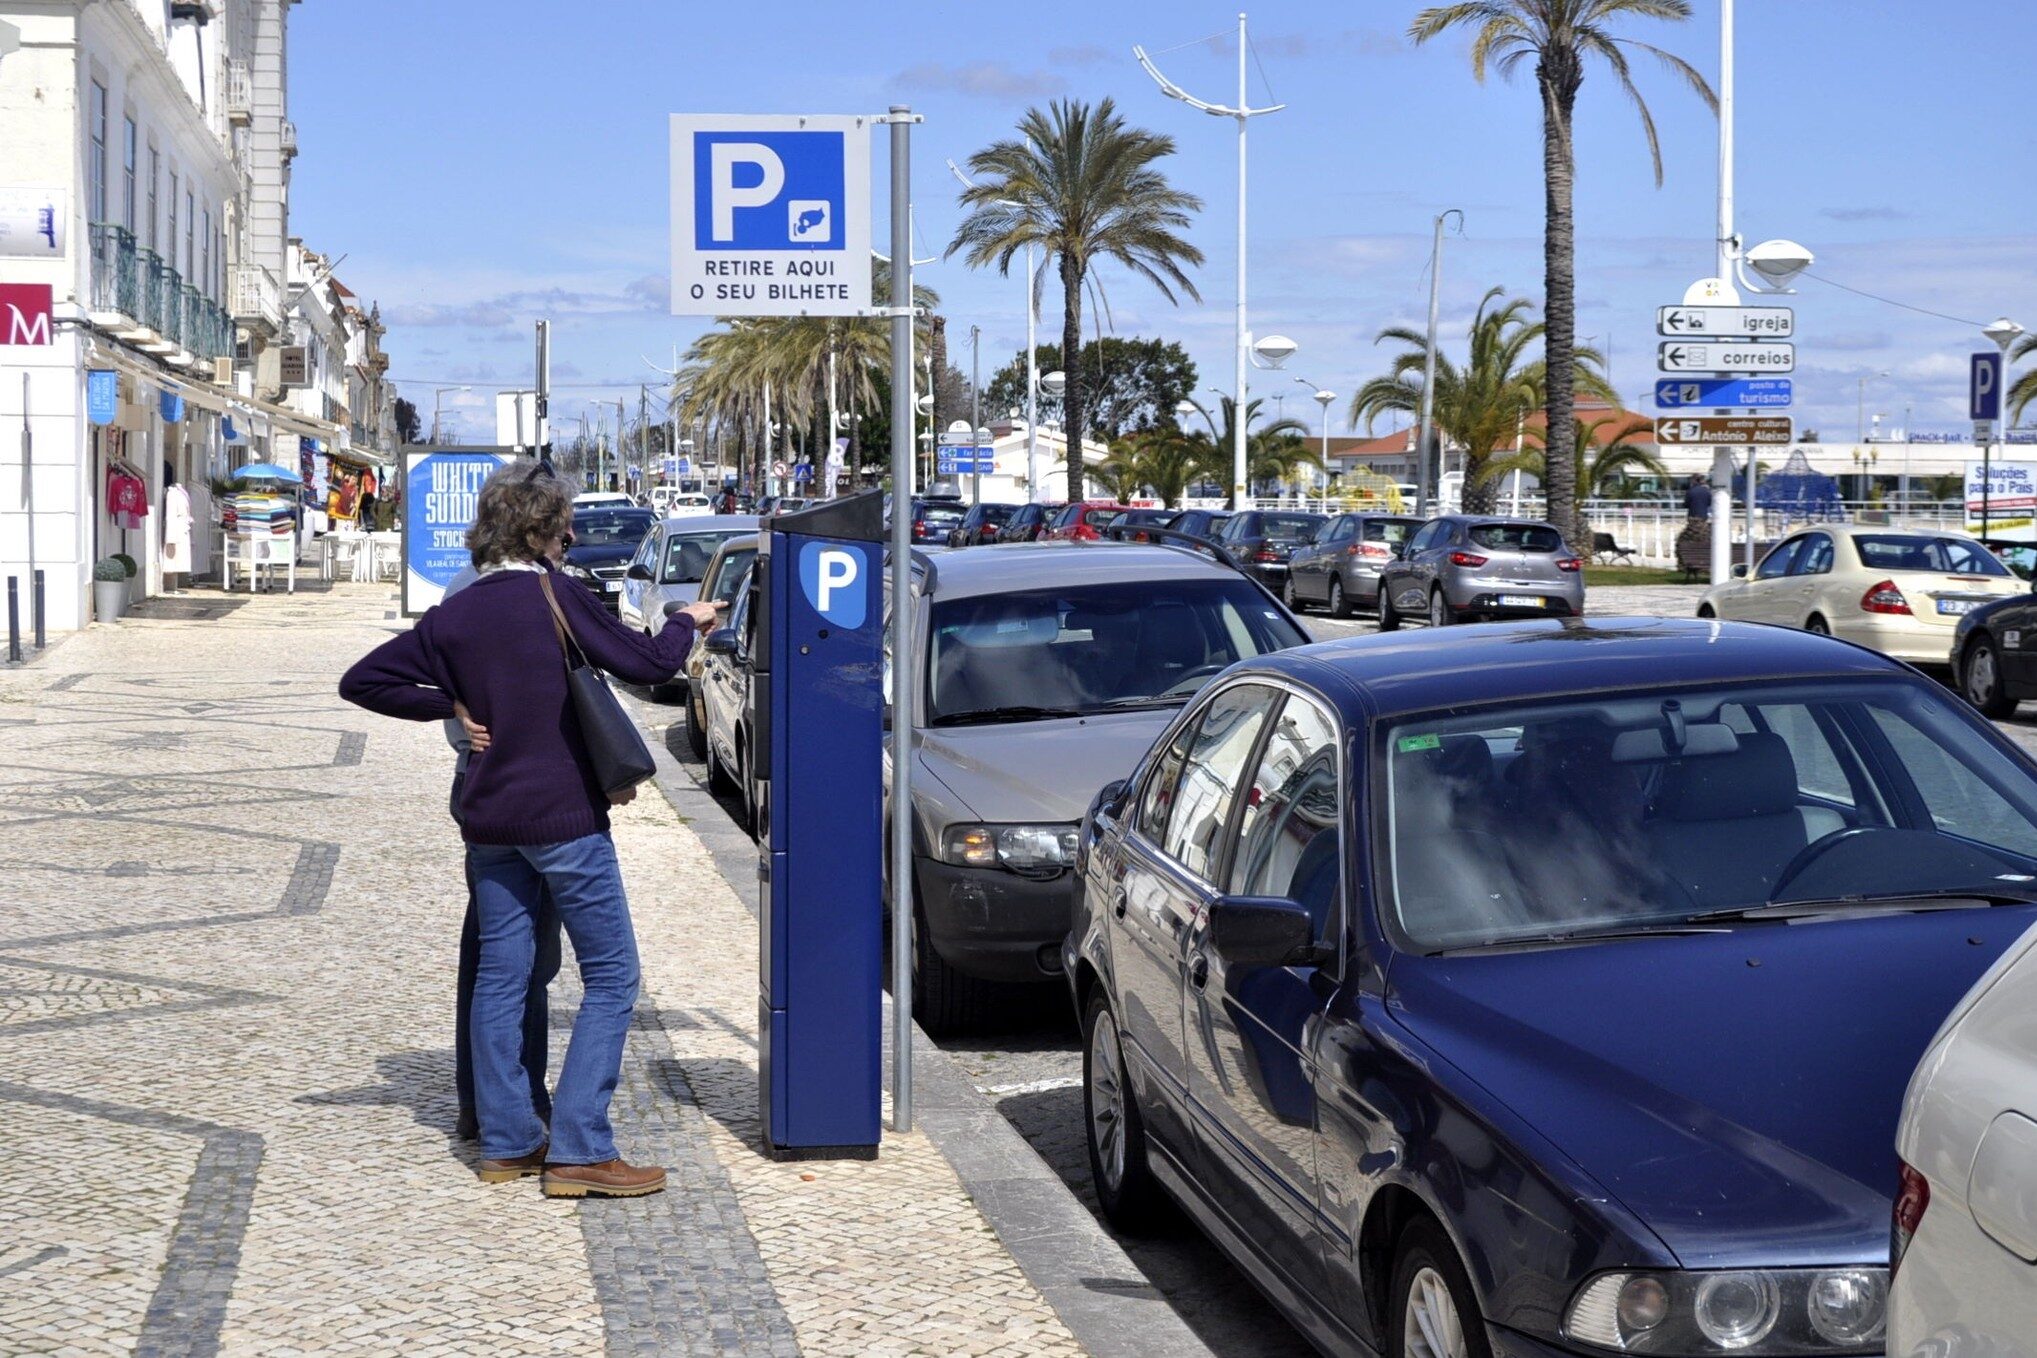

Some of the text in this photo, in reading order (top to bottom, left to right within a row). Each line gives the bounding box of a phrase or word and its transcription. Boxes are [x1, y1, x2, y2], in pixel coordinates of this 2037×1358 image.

[711, 143, 785, 241] P
[705, 261, 835, 277] RETIRE AQUI
[690, 284, 849, 299] O SEU BILHETE
[7, 304, 50, 344] M
[1743, 315, 1789, 331] igreja
[1723, 351, 1791, 364] correios
[1749, 381, 1789, 390] posto de
[1975, 360, 1994, 413] P
[1739, 392, 1789, 403] turismo
[1702, 430, 1789, 441] António Aleixo
[1976, 466, 2028, 481] Sluções
[1968, 483, 1994, 495] paa
[426, 493, 479, 523] SUND
[818, 551, 857, 612] P
